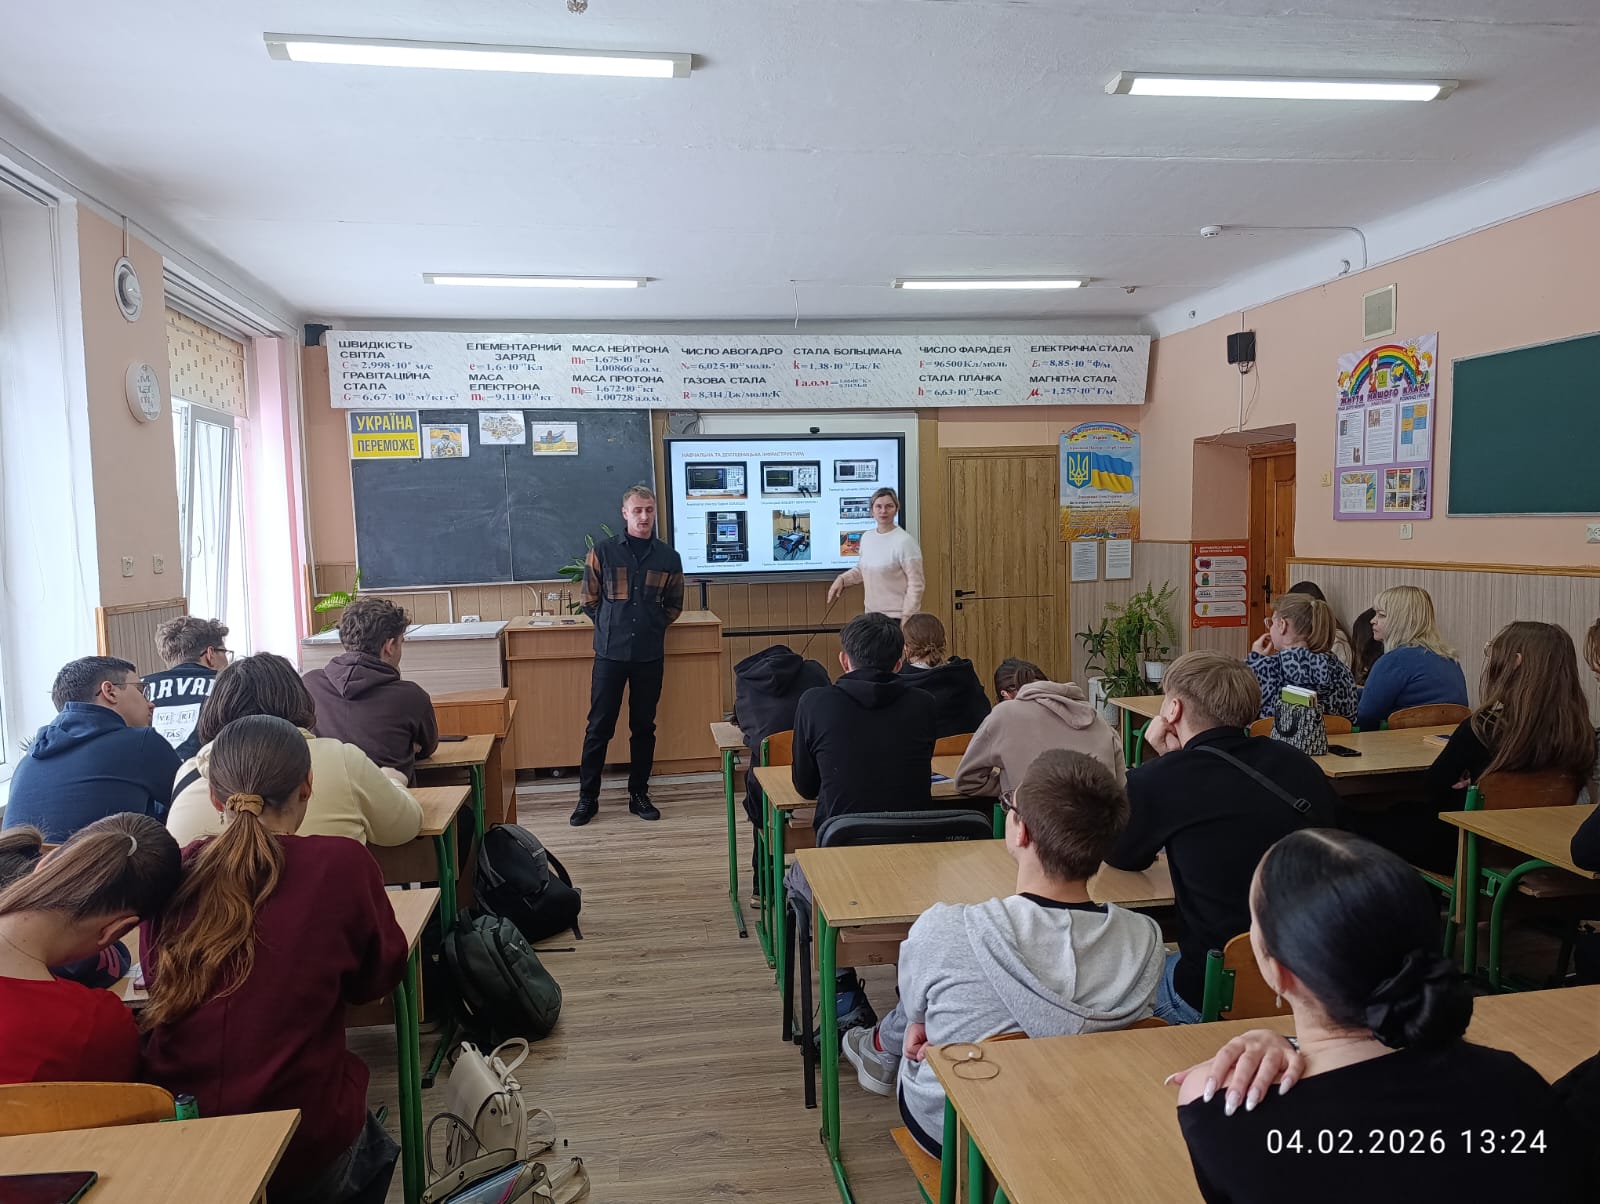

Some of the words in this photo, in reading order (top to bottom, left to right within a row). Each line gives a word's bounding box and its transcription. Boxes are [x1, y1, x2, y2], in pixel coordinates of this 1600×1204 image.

[338, 341, 413, 350] ШВИДКІСТЬ
[466, 342, 562, 351] ЕЛЕМЕНТАРНИЙ
[608, 345, 669, 354] НЕЙТРОНА
[495, 353, 536, 362] ЗАРЯД
[343, 372, 431, 380] ГРАВІТАЦІЙНА
[1341, 394, 1364, 405] ЖИТТЯ
[1367, 389, 1398, 400] НАШОГО
[1403, 383, 1430, 394] КЛАСУ
[356, 412, 413, 431] УКРАЇНА
[358, 438, 416, 452] ПЕРЕМОЖЕ
